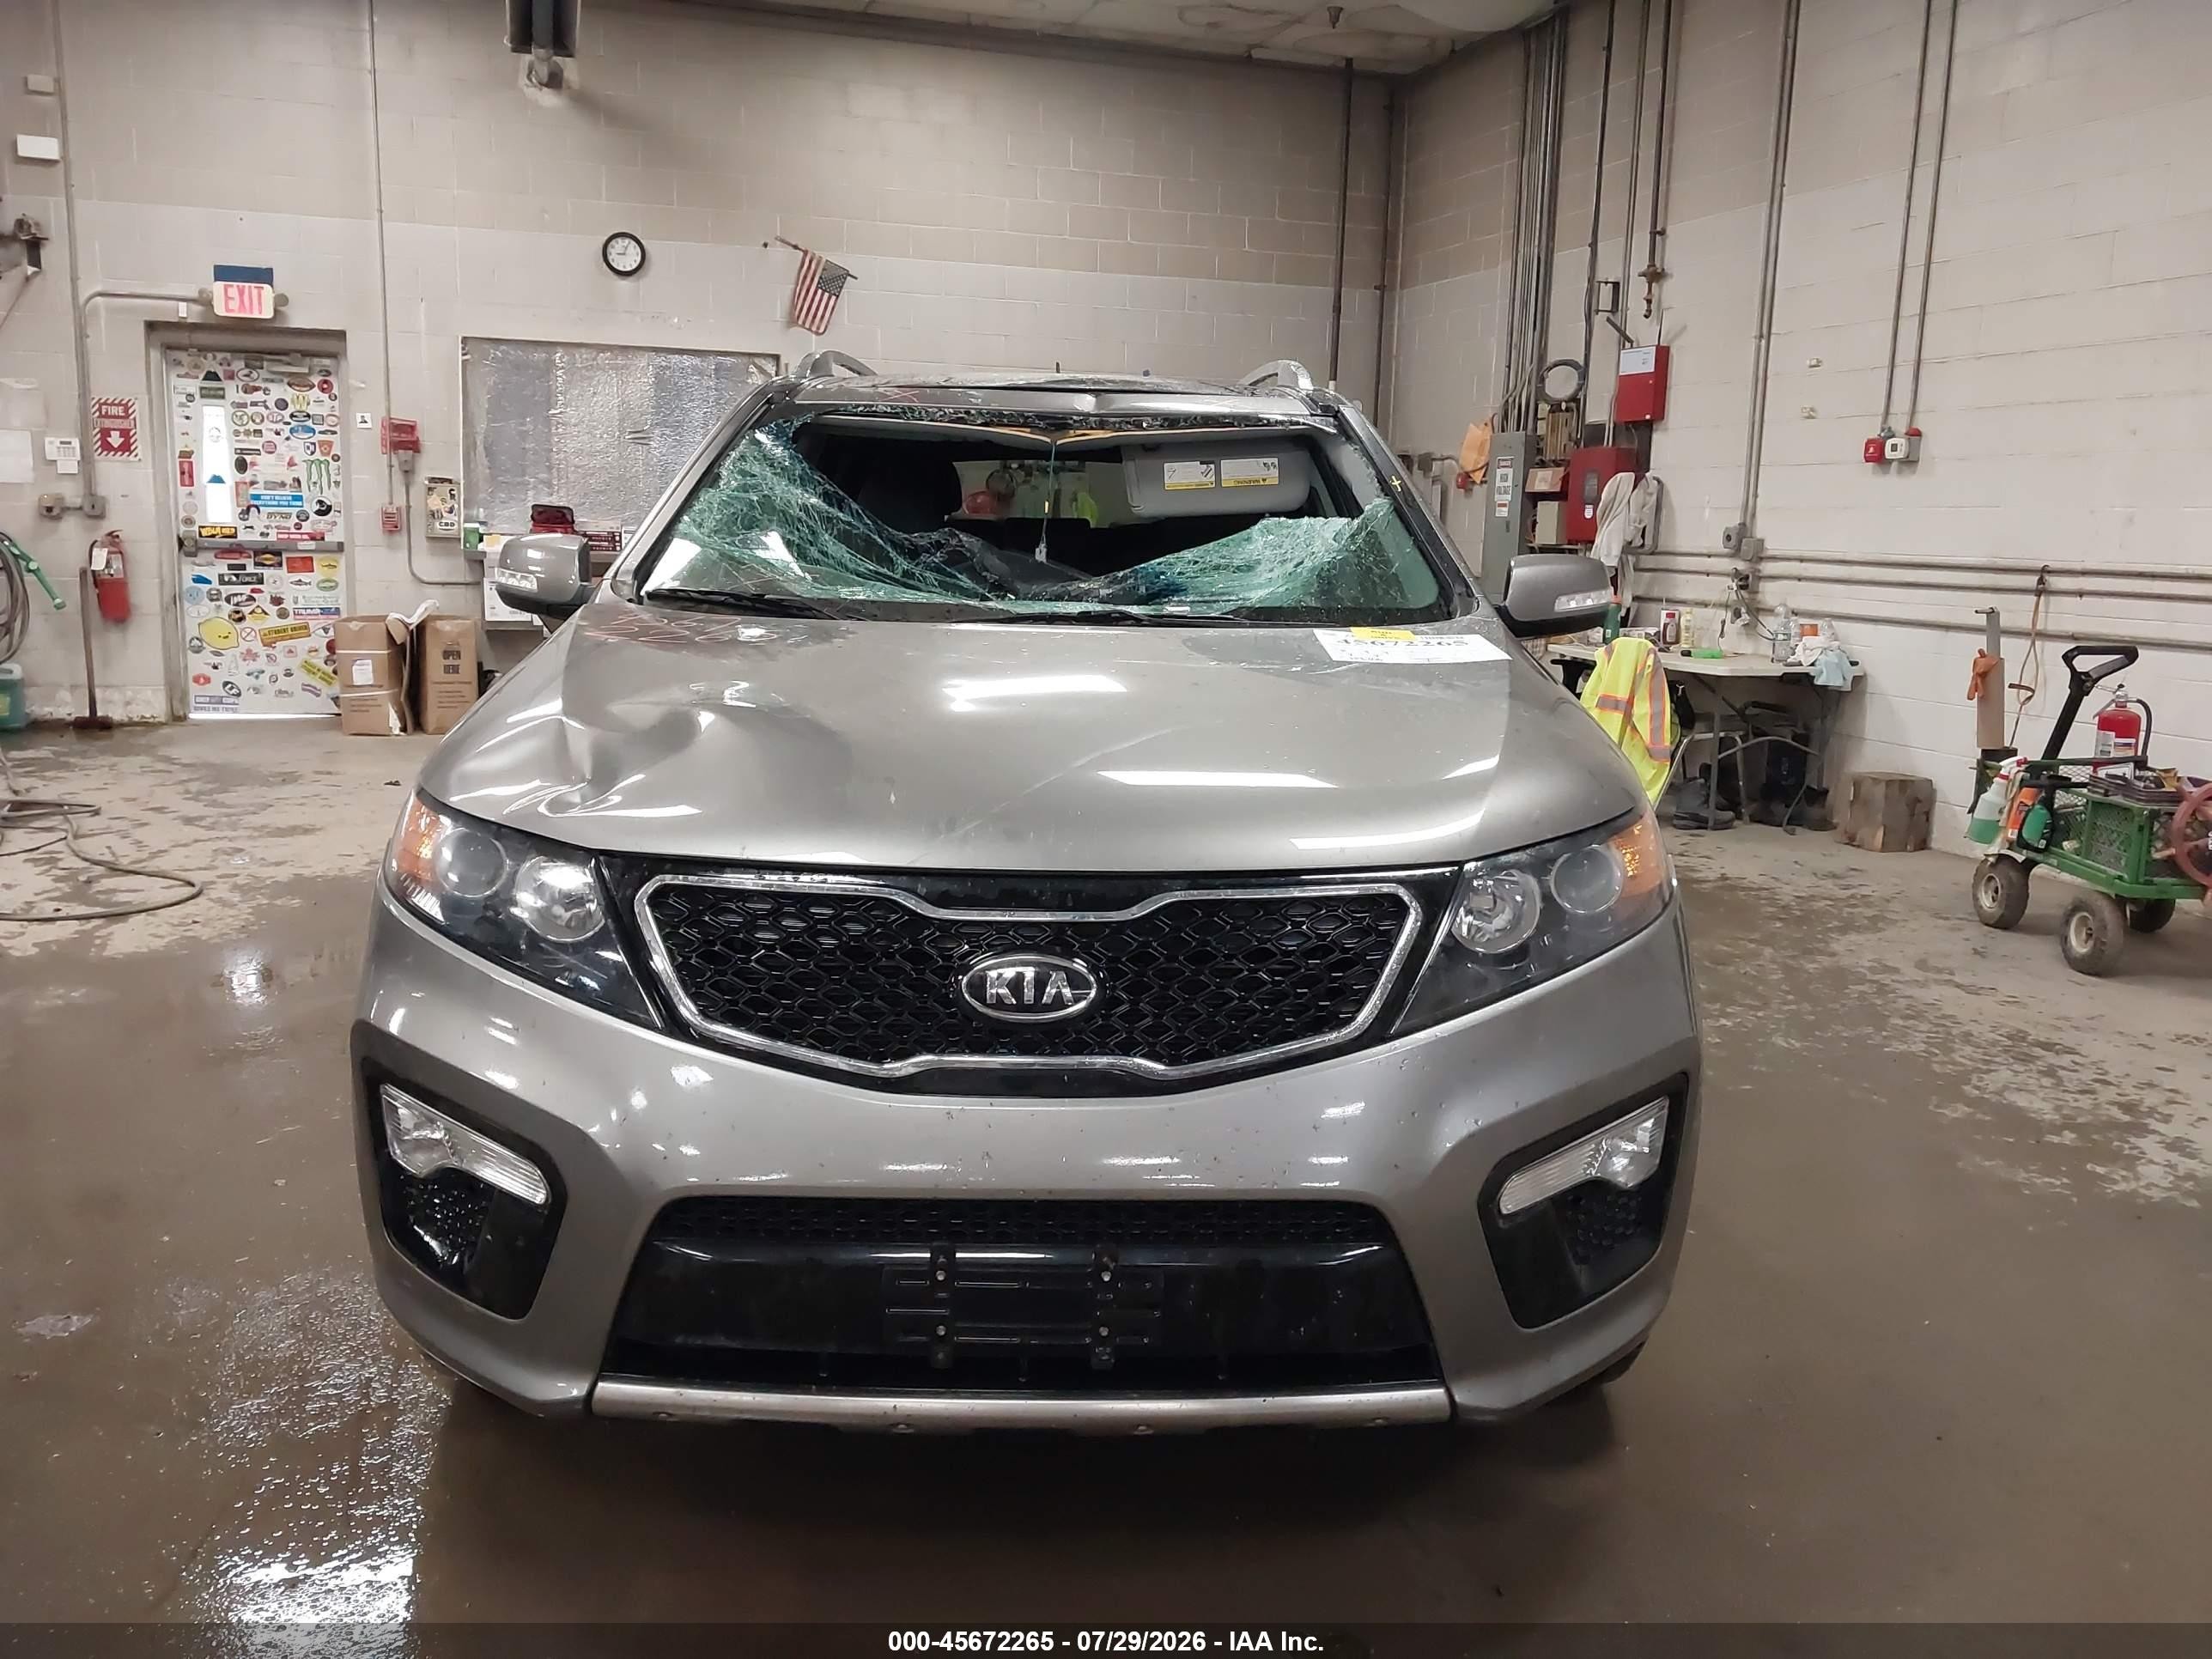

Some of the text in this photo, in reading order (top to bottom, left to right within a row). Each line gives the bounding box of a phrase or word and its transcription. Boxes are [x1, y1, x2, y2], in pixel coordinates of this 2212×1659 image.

[223, 284, 264, 315] EXIT
[101, 405, 125, 416] FIRE
[443, 650, 461, 659] OPEN
[985, 966, 1074, 1006] KIA
